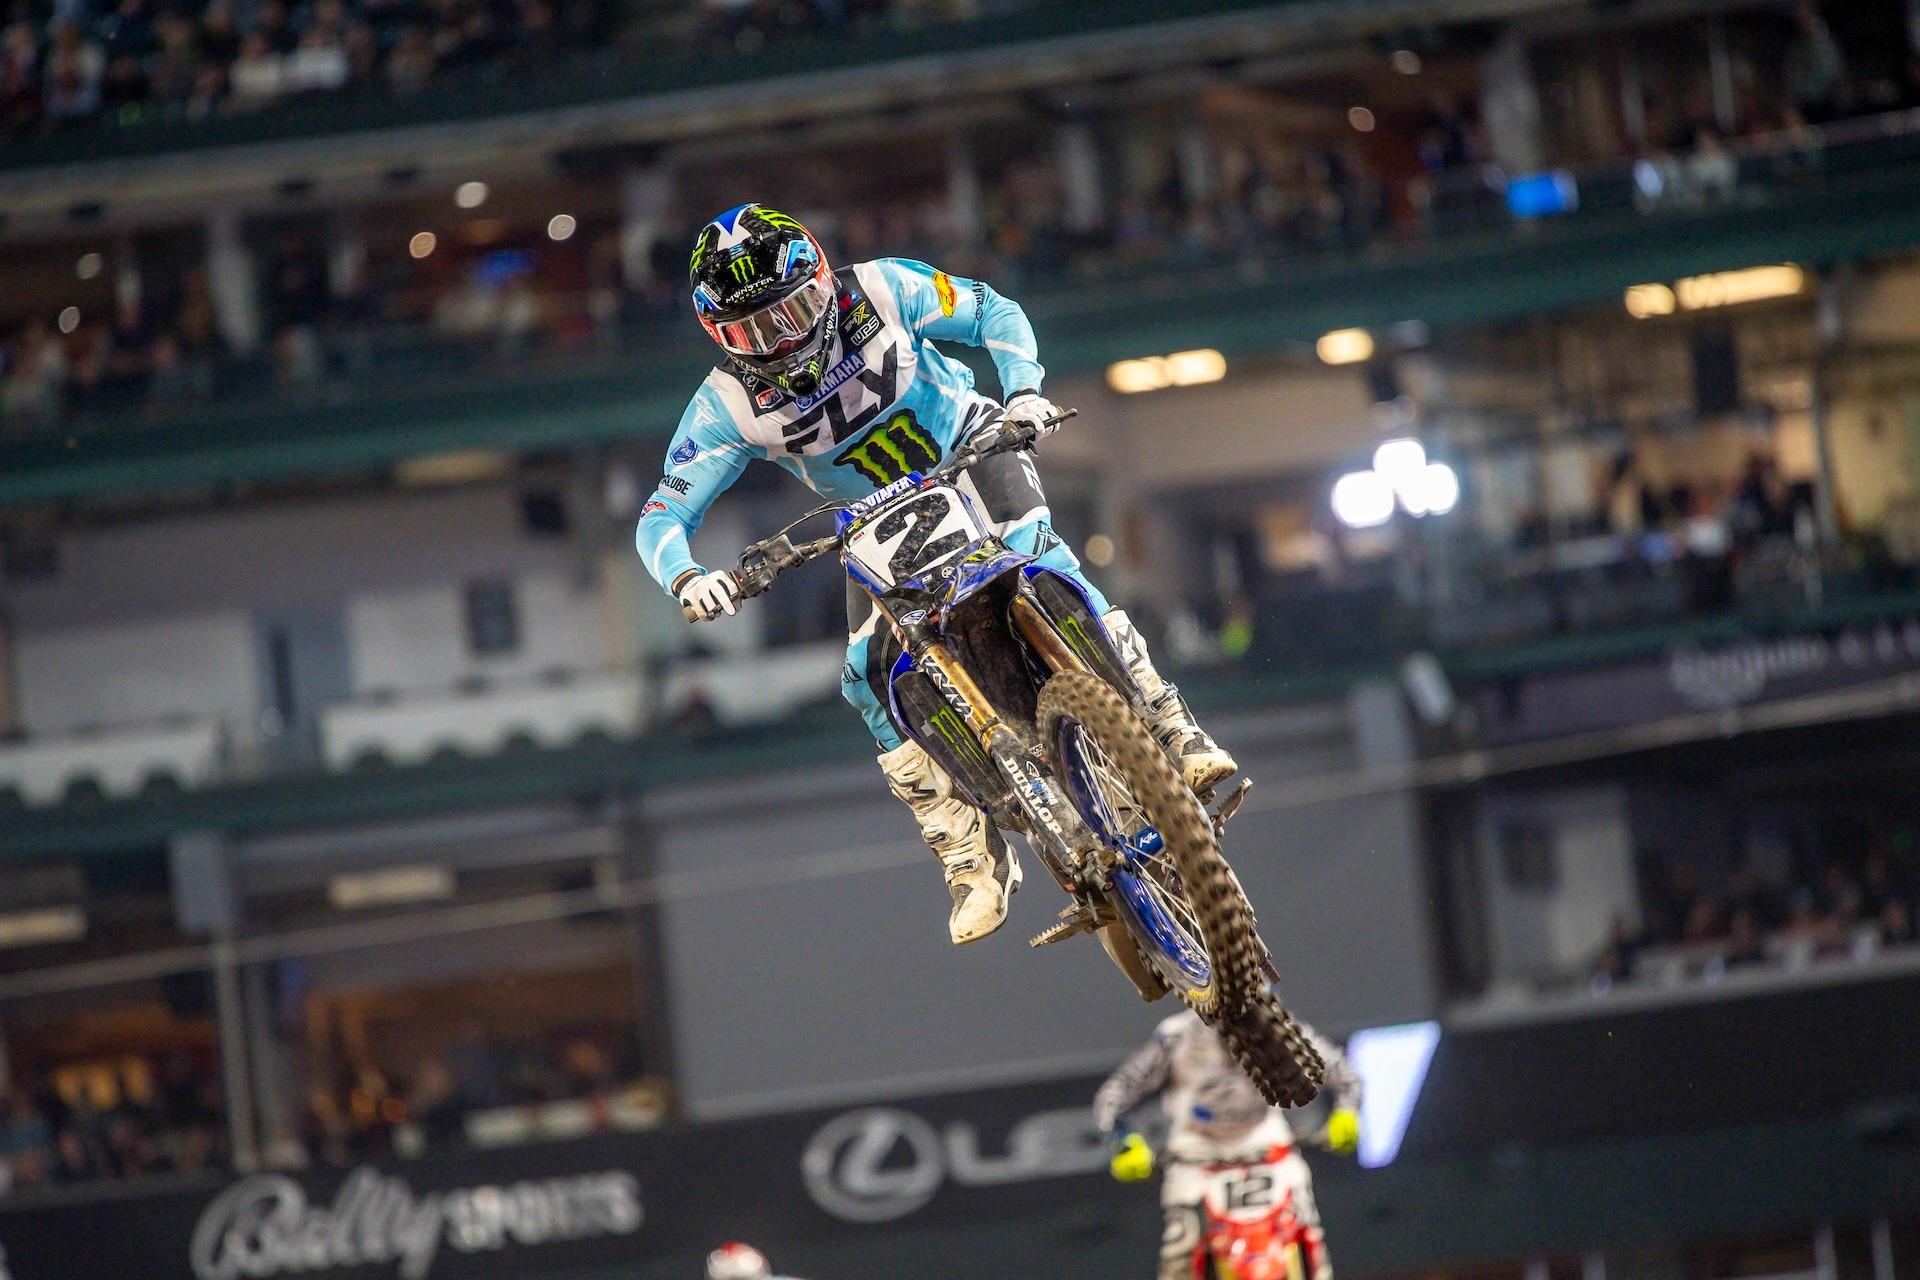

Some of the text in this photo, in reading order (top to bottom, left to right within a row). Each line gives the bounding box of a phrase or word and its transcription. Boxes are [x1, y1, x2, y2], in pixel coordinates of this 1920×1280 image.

[850, 314, 880, 347] WPS
[875, 492, 971, 586] 2
[1000, 757, 1063, 833] DUNLOP
[1225, 1175, 1274, 1209] 12
